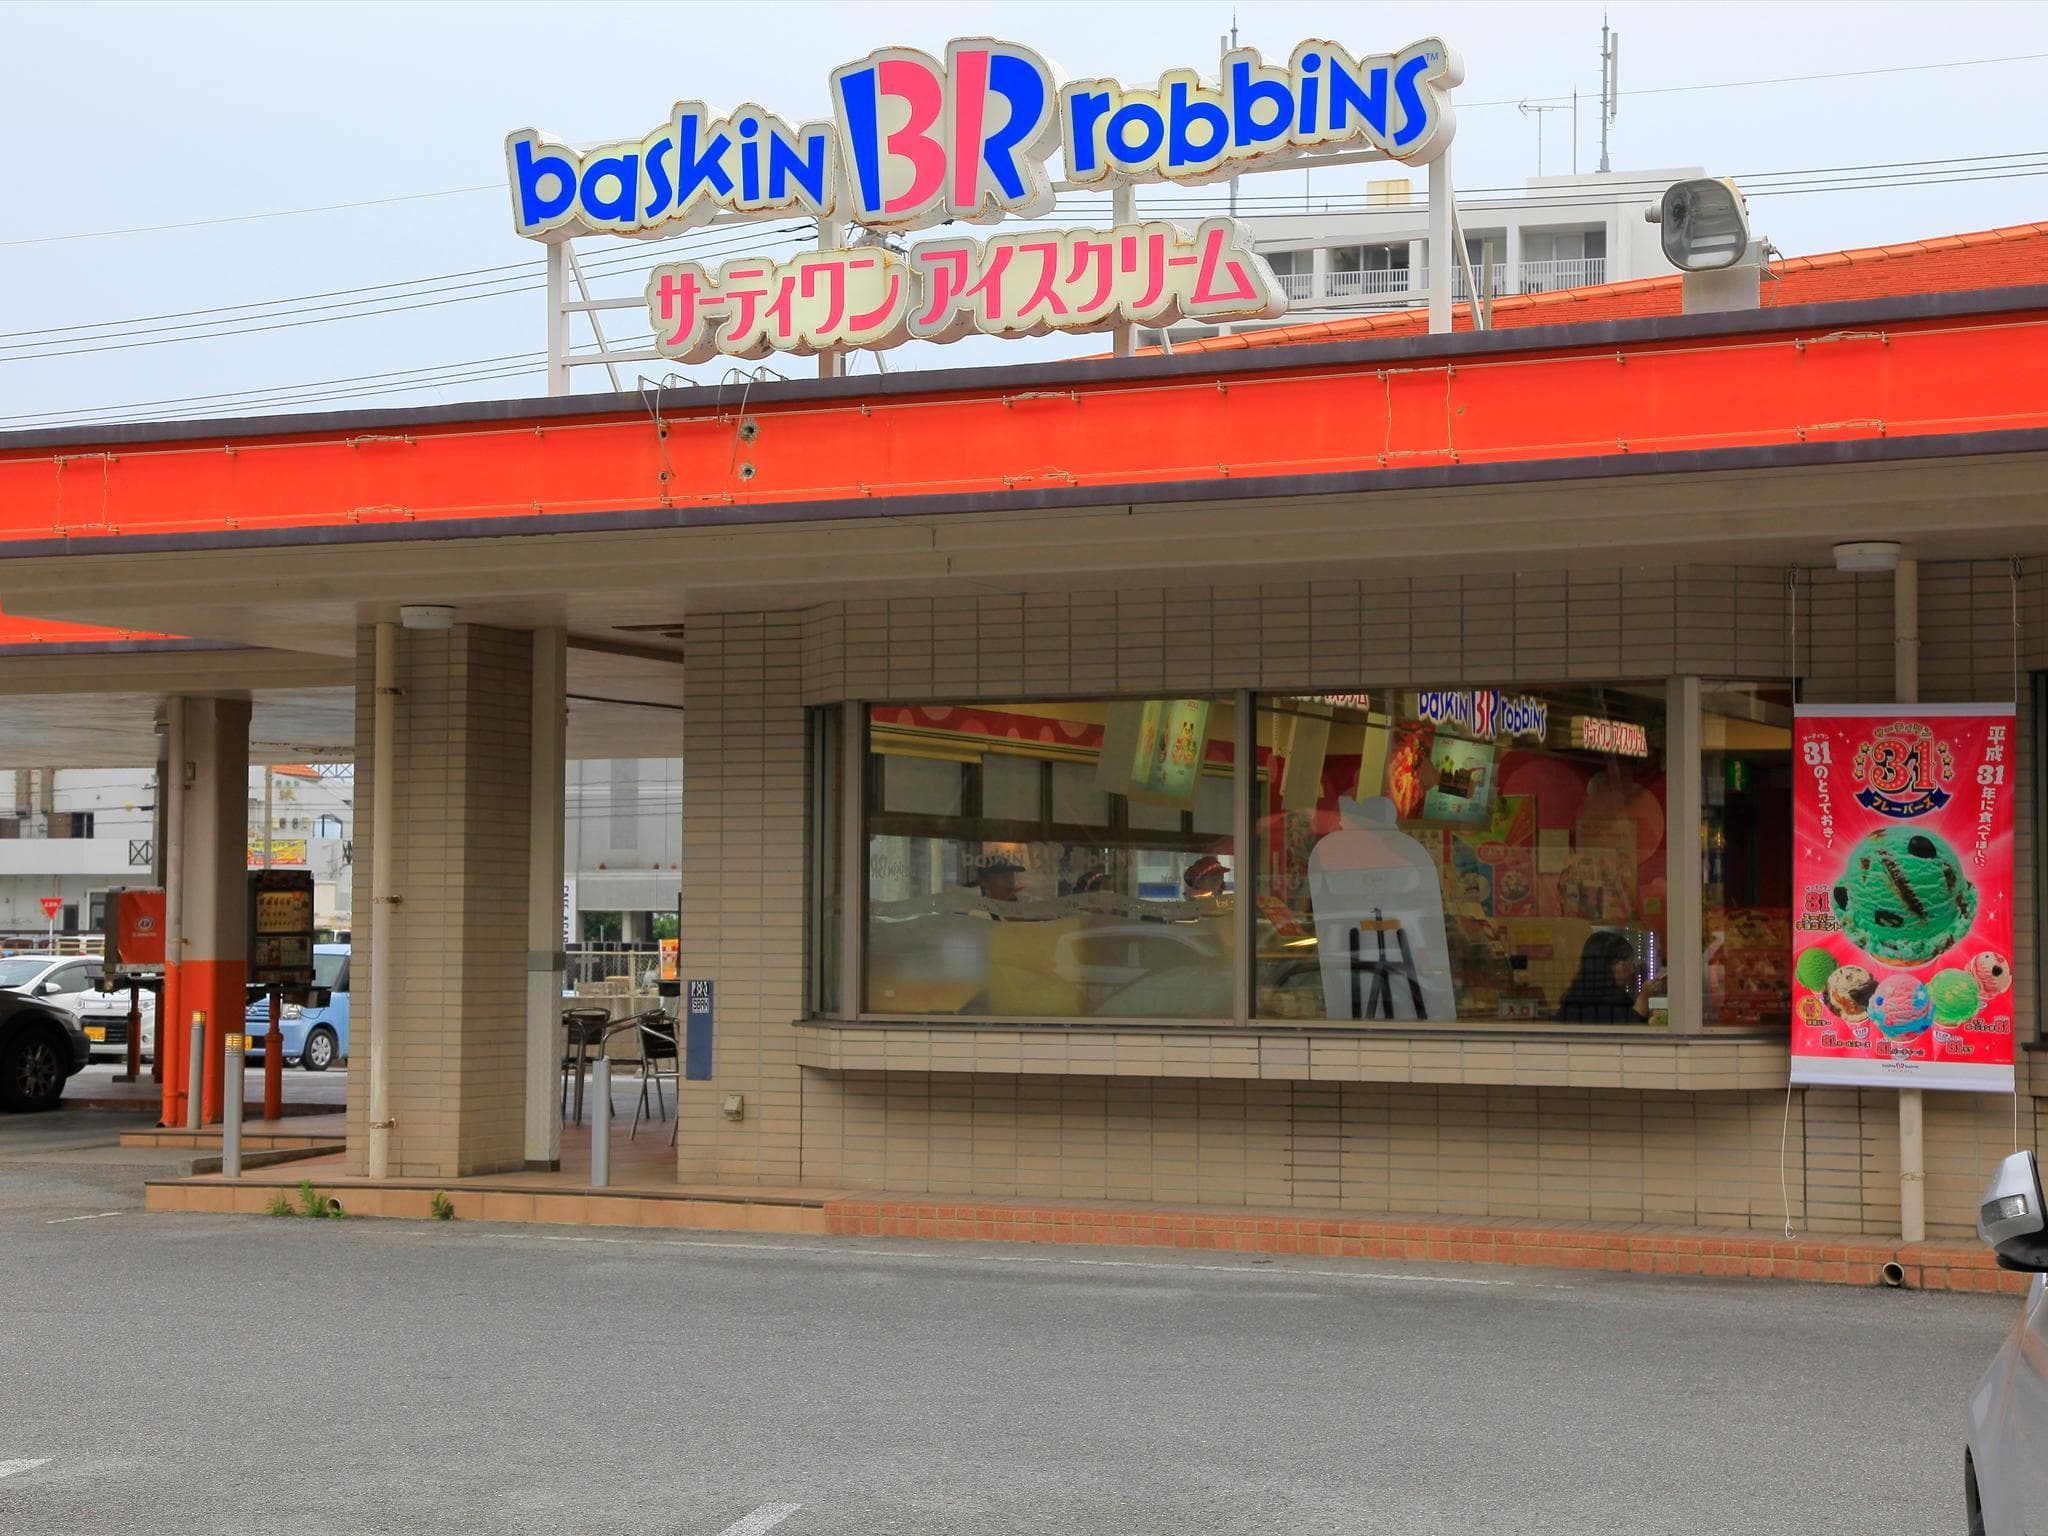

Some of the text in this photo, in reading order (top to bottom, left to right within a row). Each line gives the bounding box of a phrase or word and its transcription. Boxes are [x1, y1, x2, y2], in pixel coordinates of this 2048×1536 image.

[840, 51, 1044, 213] BR
[656, 230, 1257, 345] サーティワン アイスクリーム
[1872, 738, 1936, 793] 31
